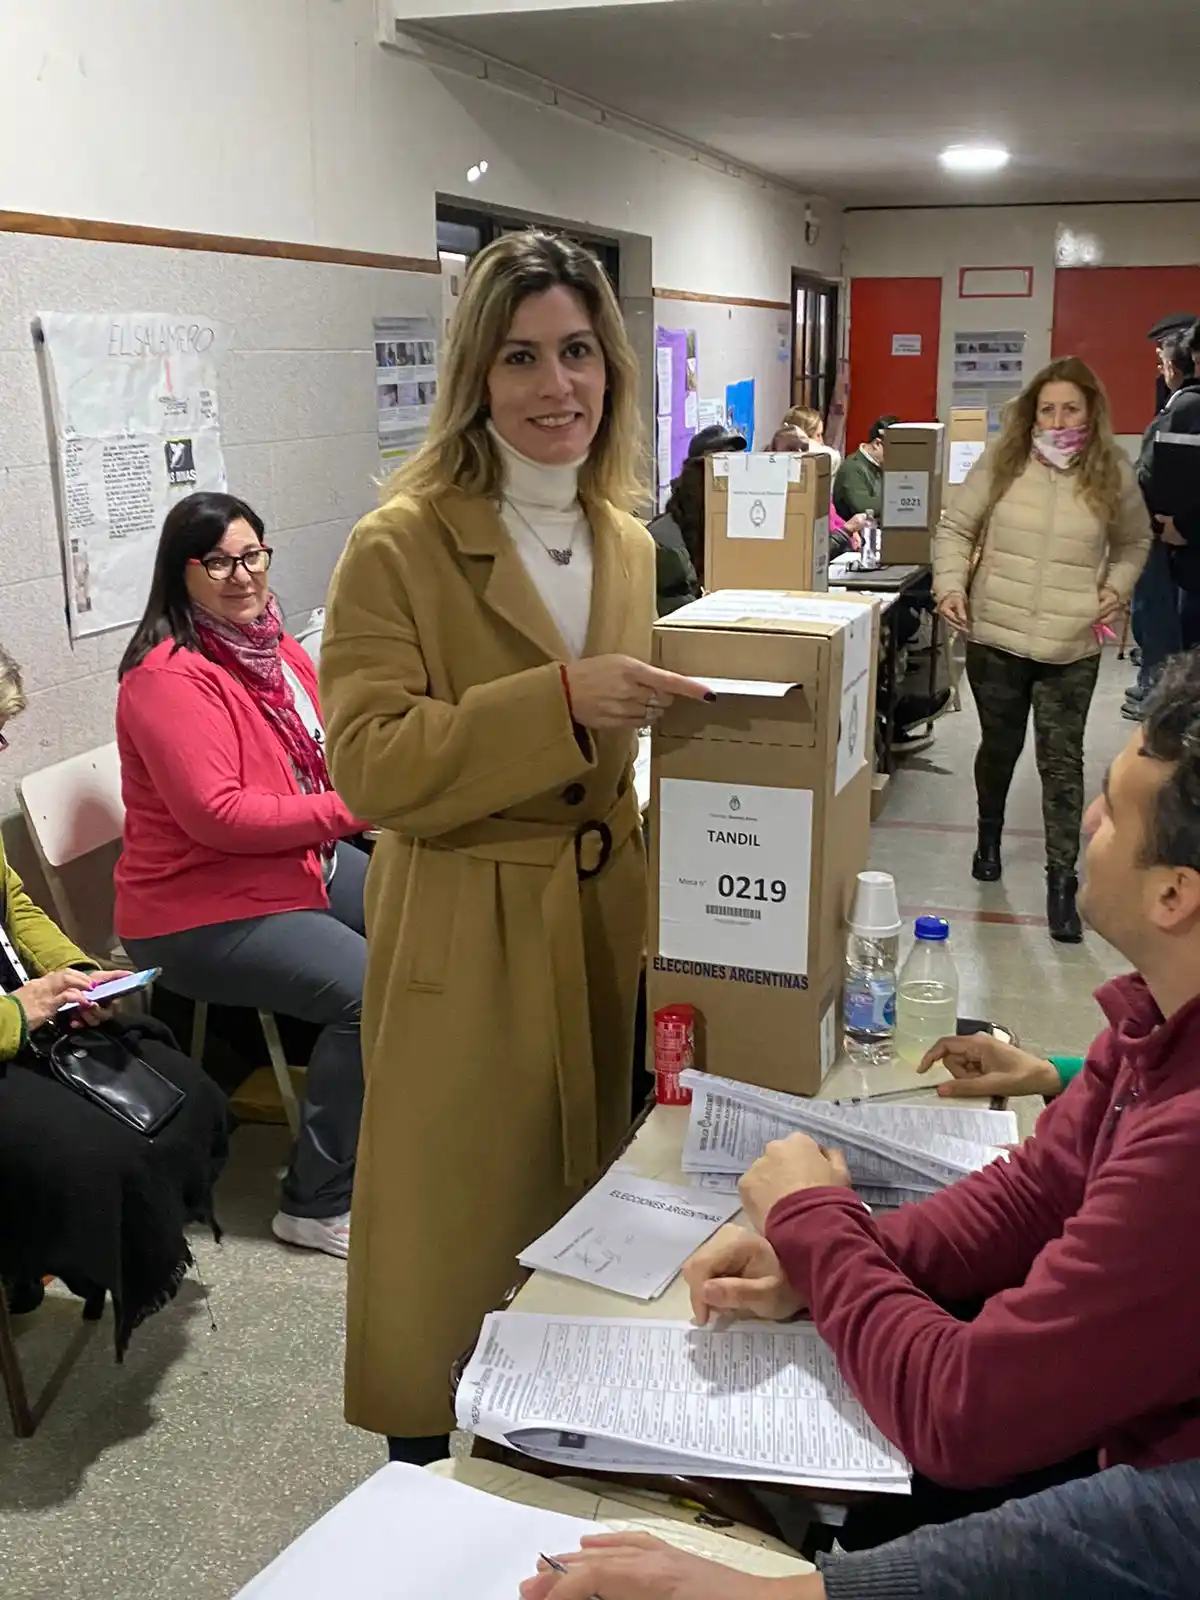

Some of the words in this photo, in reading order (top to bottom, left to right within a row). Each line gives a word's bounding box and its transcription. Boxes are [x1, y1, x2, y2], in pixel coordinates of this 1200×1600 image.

[707, 829, 761, 847] TANDIL
[718, 873, 787, 903] 0219
[653, 956, 727, 981] ELECCIONES
[729, 965, 809, 991] ARGENTINAS
[609, 1189, 666, 1210] ELECCIONES
